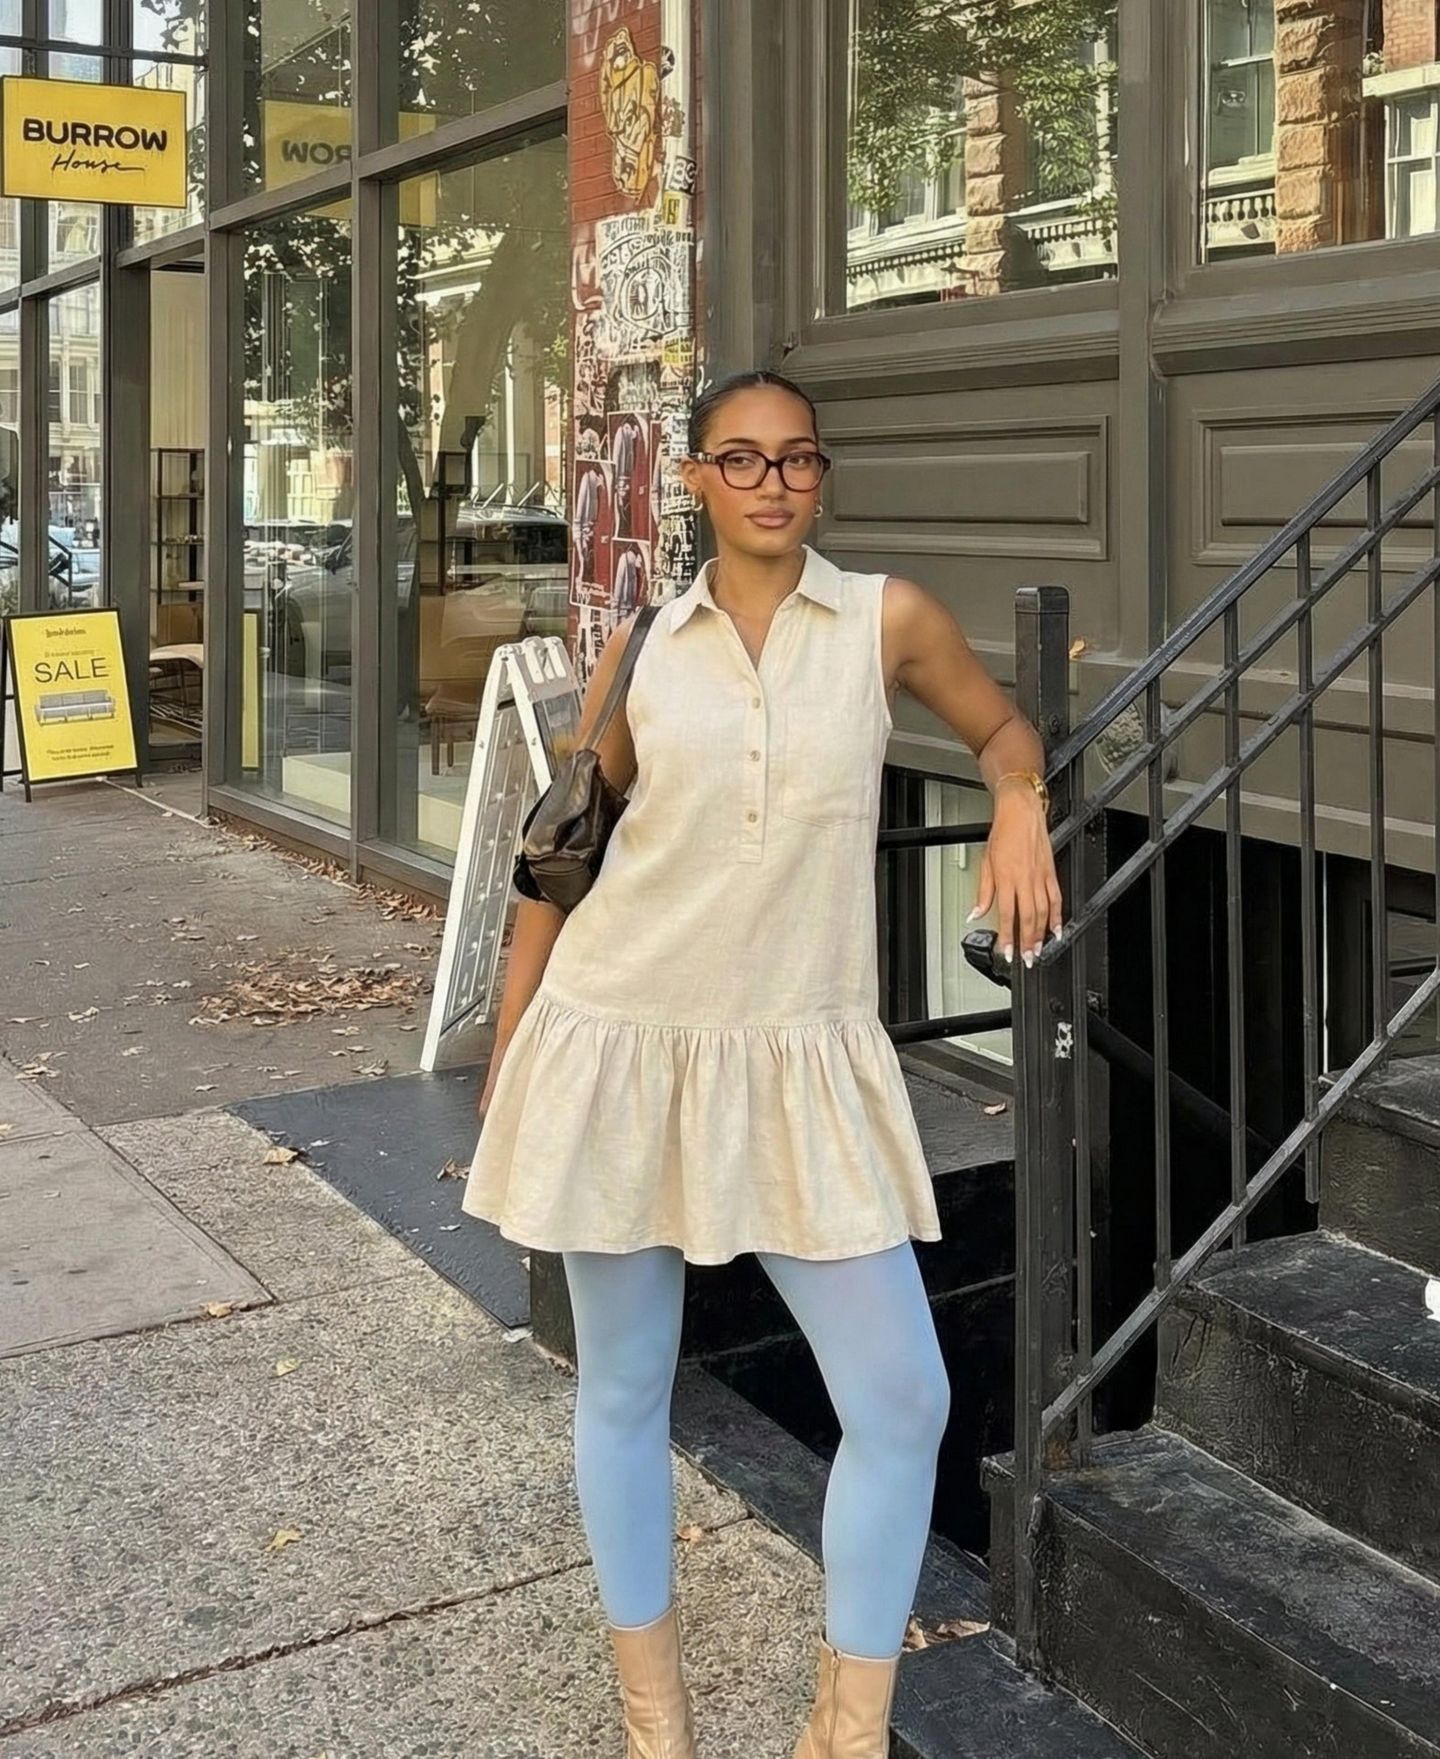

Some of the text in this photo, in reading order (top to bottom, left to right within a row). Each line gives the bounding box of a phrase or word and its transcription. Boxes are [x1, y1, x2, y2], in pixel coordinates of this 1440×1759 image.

[23, 118, 168, 151] BURROW
[50, 149, 145, 174] House
[34, 657, 109, 683] SALE
